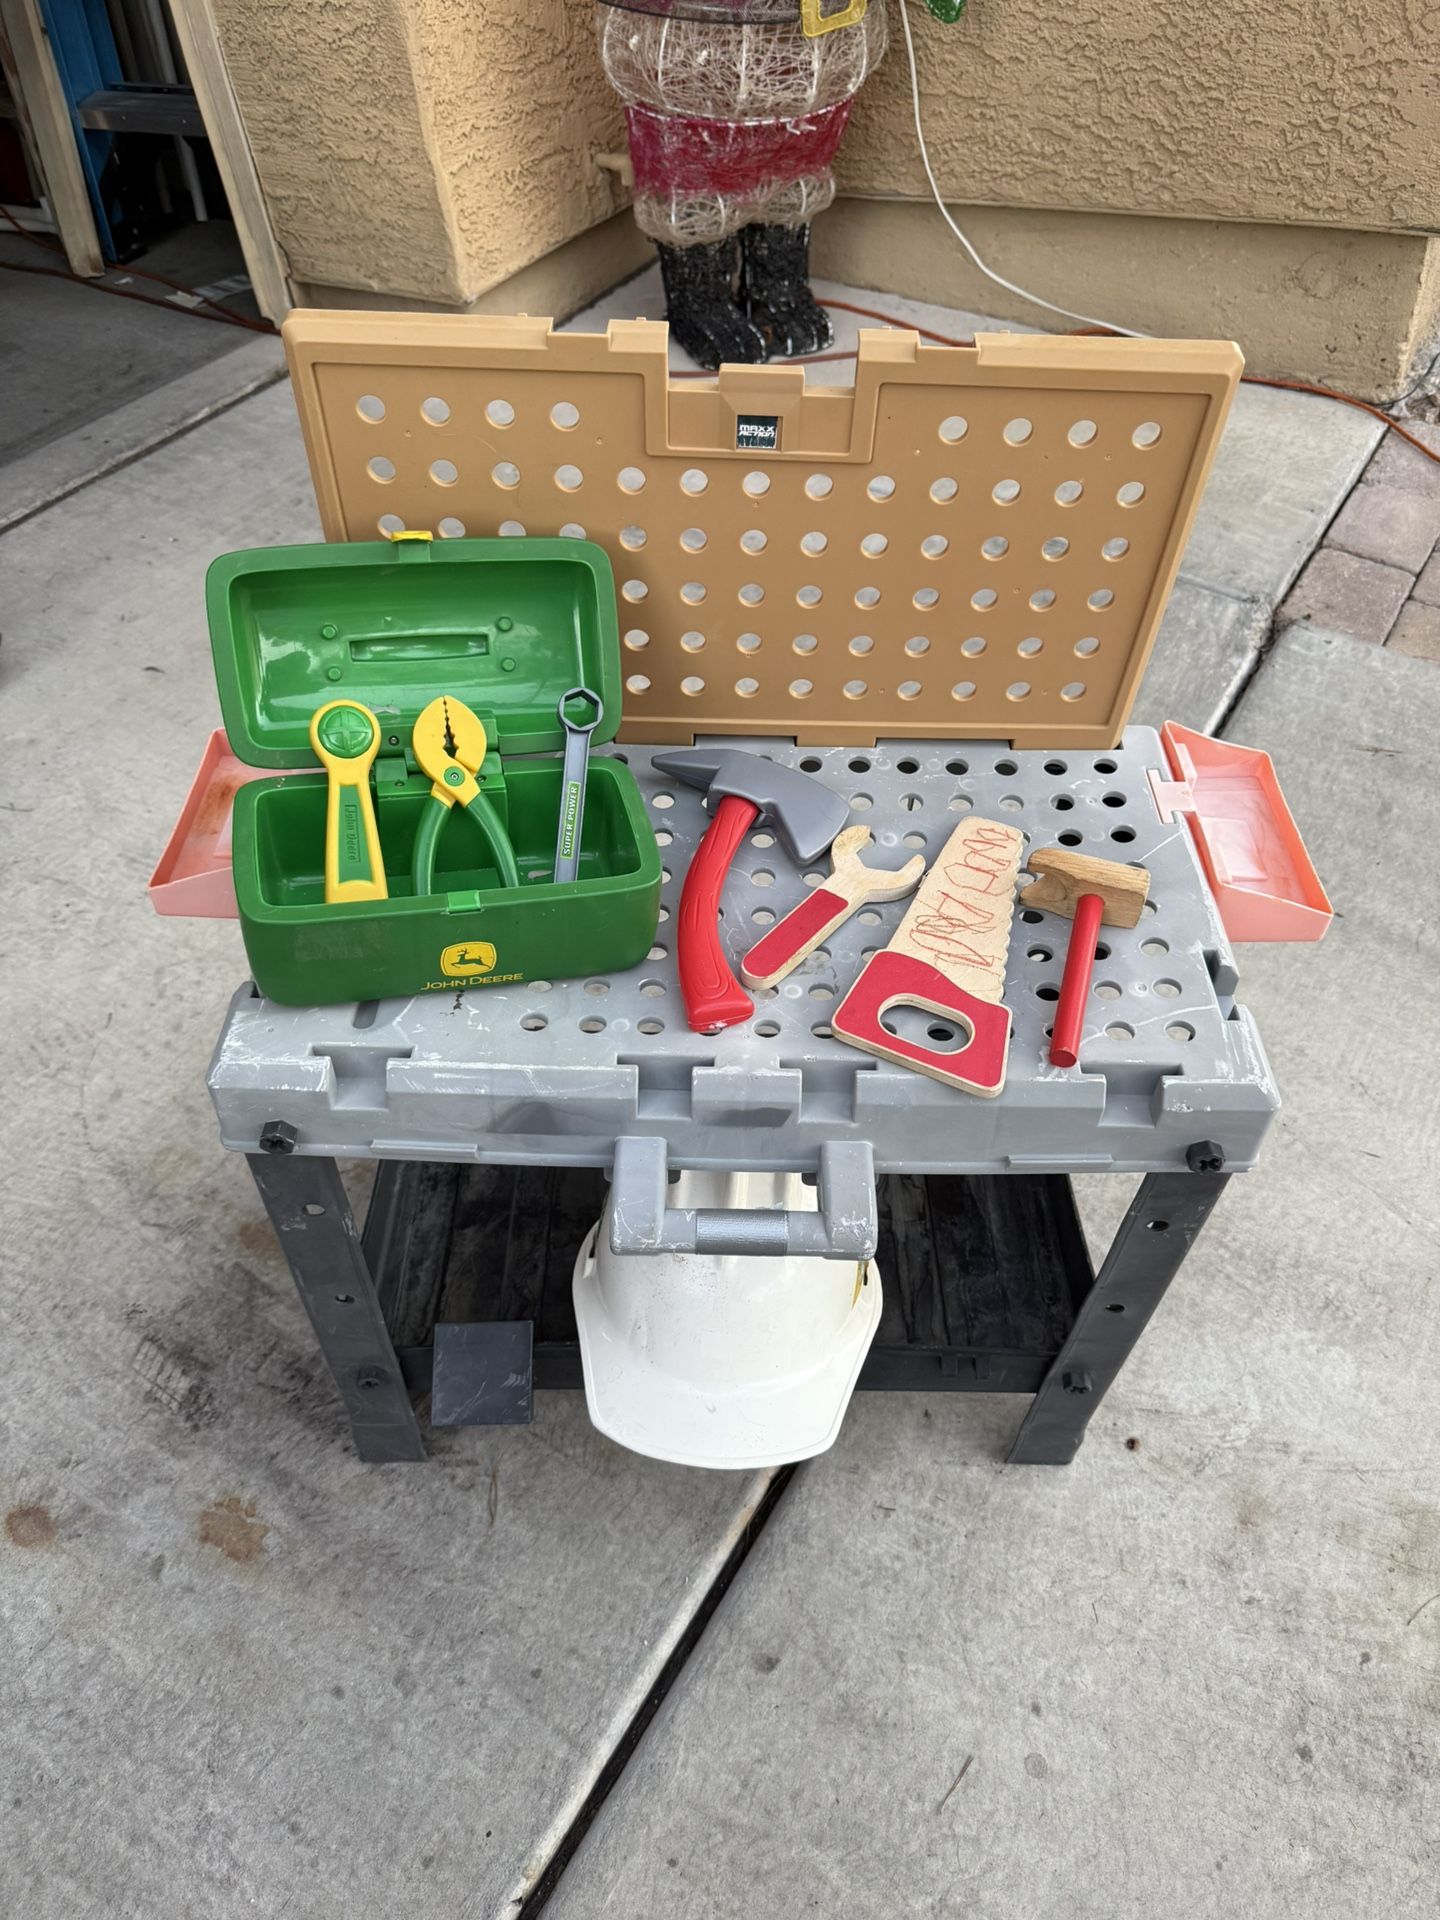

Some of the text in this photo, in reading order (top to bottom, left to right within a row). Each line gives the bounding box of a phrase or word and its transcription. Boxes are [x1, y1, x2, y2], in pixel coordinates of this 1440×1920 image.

[563, 786, 577, 855] SUPER POWER
[421, 973, 524, 990] JOHN DEERE
